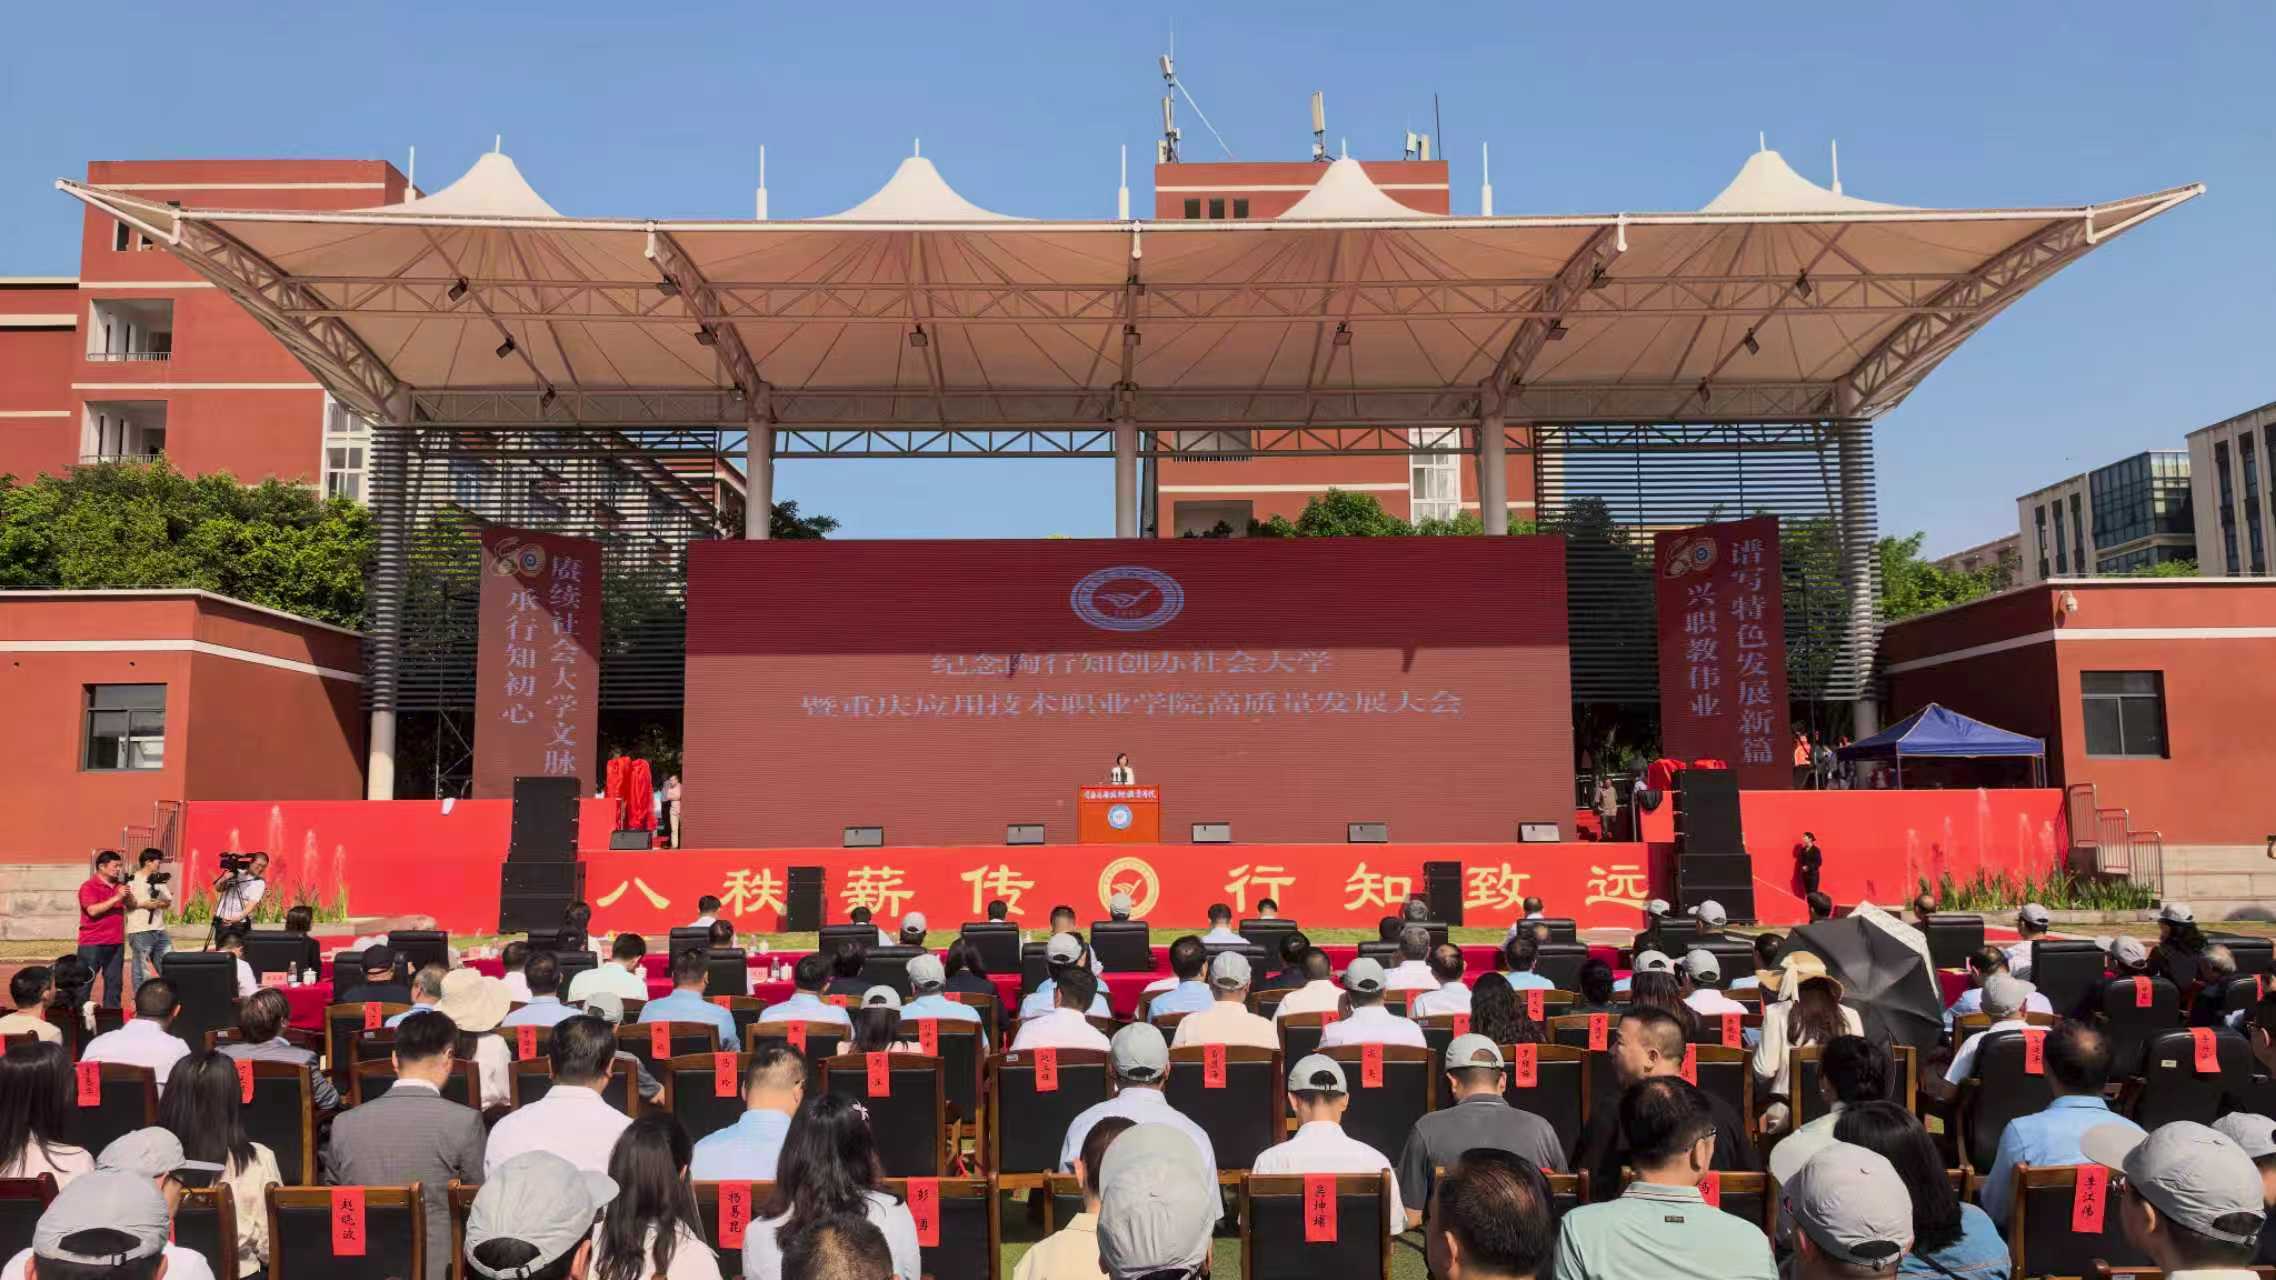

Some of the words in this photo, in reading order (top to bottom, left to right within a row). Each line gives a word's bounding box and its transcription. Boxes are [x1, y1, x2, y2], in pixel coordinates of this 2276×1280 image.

[500, 588, 538, 725] 承行知初心
[1685, 582, 1722, 716] 兴职教伟业
[1731, 538, 1775, 763] 谱写特色发展新篇
[596, 863, 1036, 917] 八秩薪传
[1223, 860, 1650, 913] 行知致远
